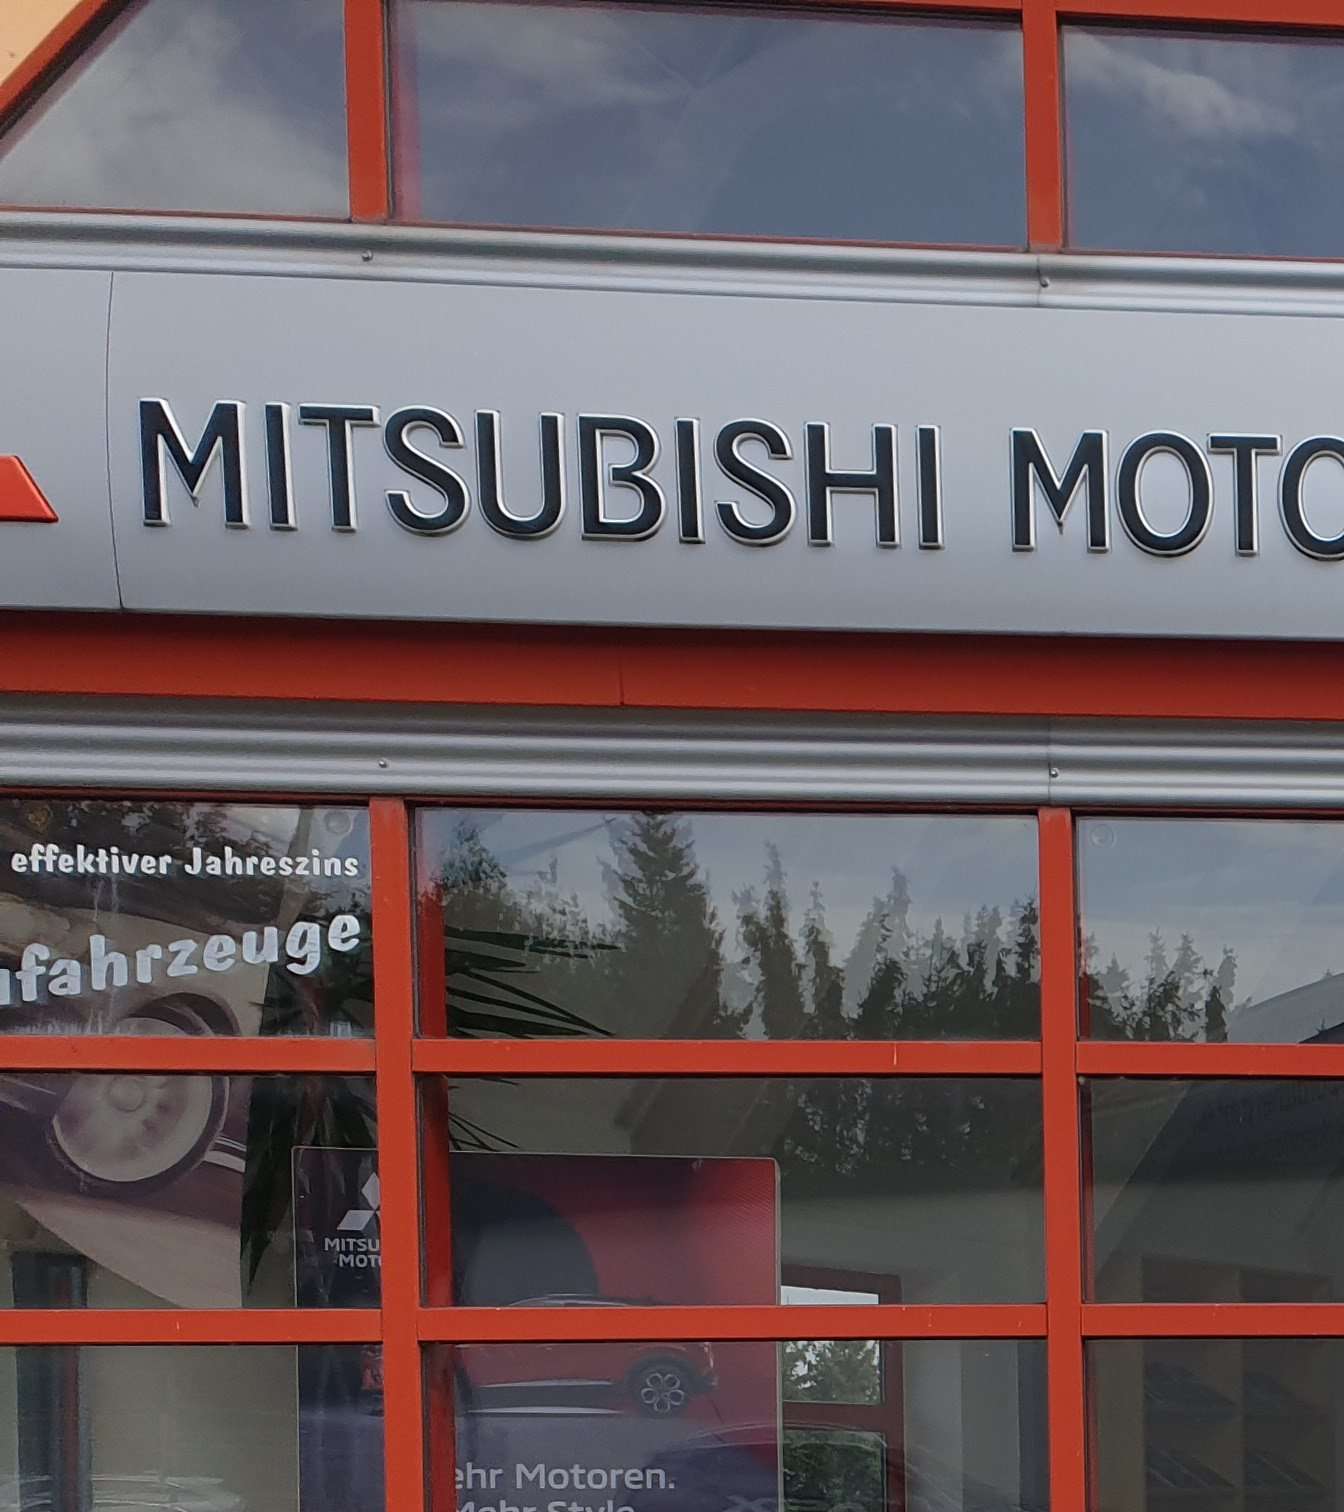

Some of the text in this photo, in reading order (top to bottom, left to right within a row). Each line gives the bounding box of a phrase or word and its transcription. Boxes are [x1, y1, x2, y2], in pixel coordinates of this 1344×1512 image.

[139, 397, 945, 550] MITSUBISHI
[10, 844, 359, 878] effektiver Jahreszins
[324, 1238, 380, 1252] MITSU
[339, 1254, 382, 1268] MOT
[455, 1463, 675, 1489] ehr Motoren.
